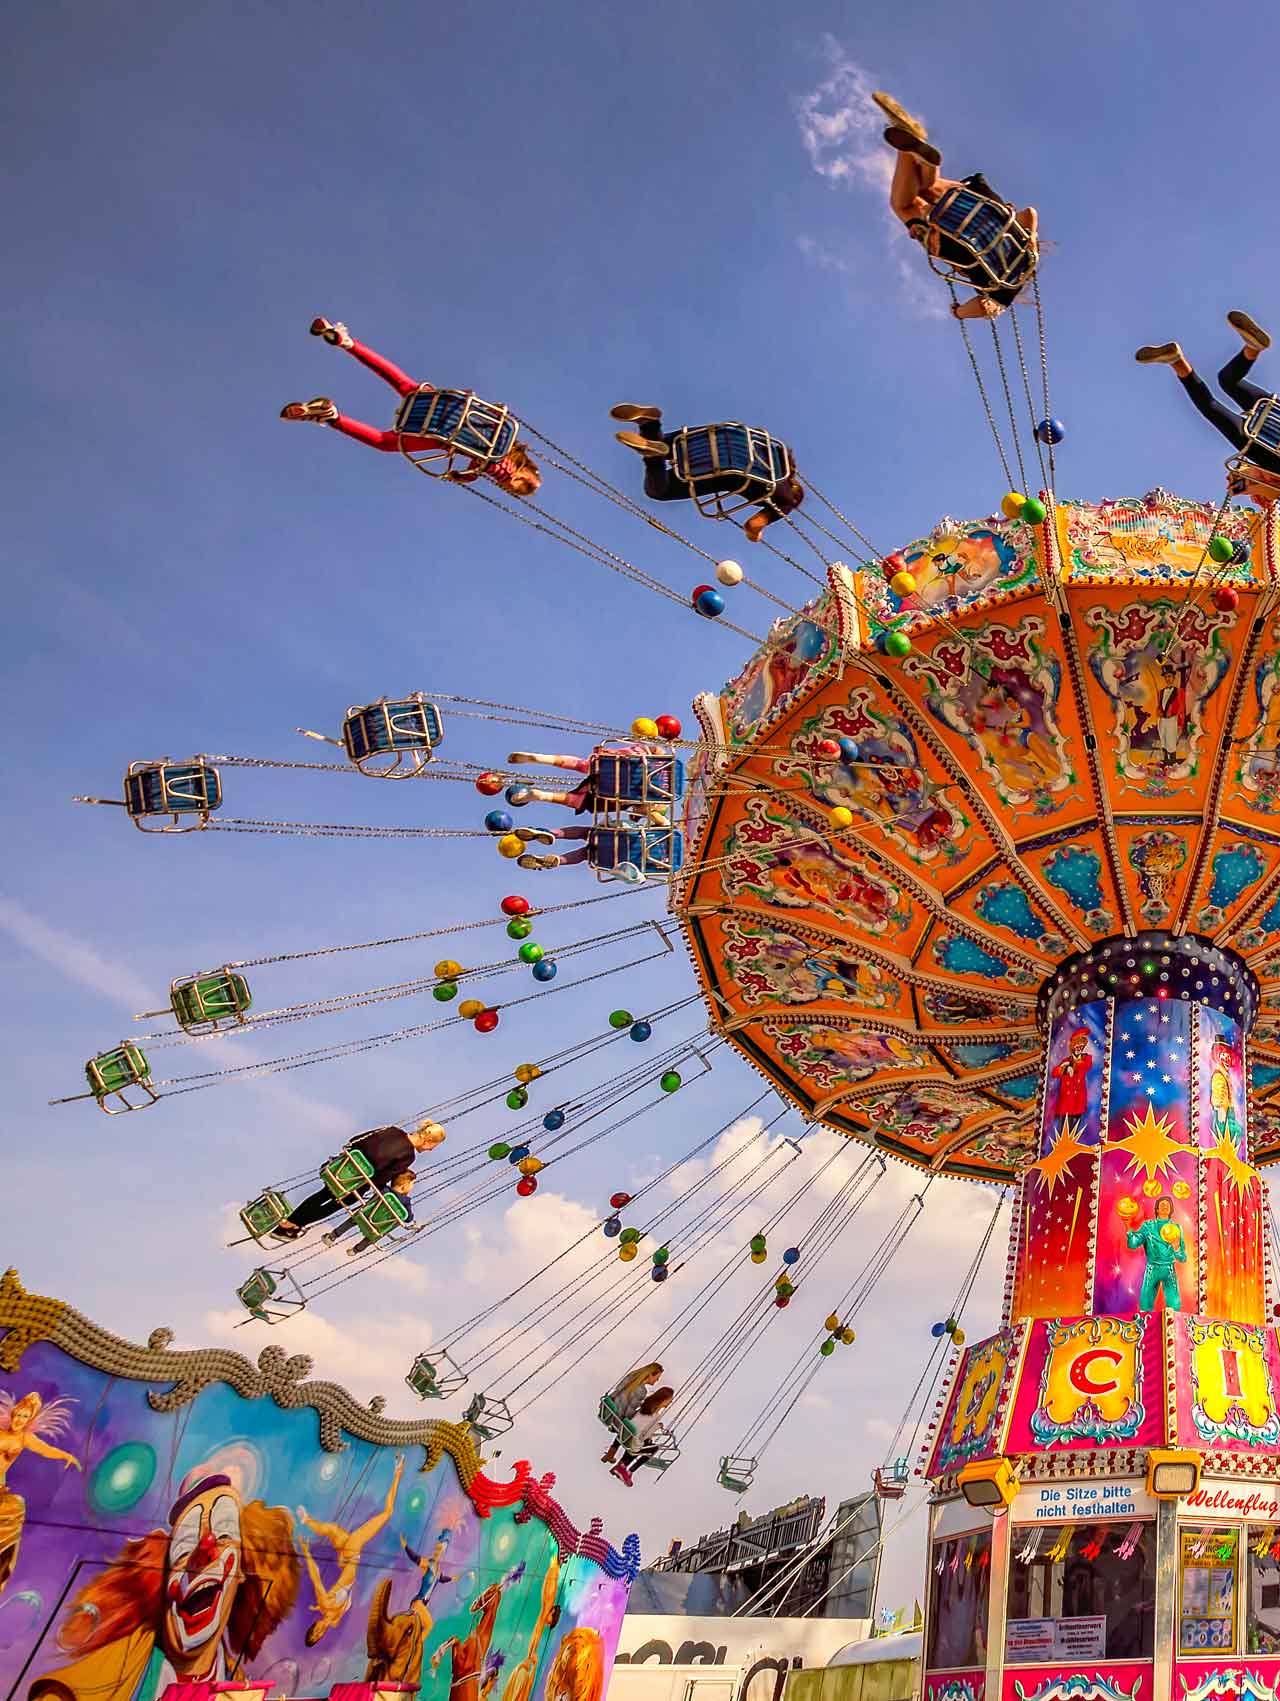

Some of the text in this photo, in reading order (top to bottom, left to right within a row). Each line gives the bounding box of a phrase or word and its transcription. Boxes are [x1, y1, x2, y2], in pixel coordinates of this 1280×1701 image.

[1070, 1349, 1123, 1394] C
[1220, 1350, 1243, 1397] I
[1040, 1485, 1132, 1501] Die Sitze bitte
[1187, 1489, 1279, 1518] Wellenflug
[1036, 1502, 1135, 1517] nicht festhalten
